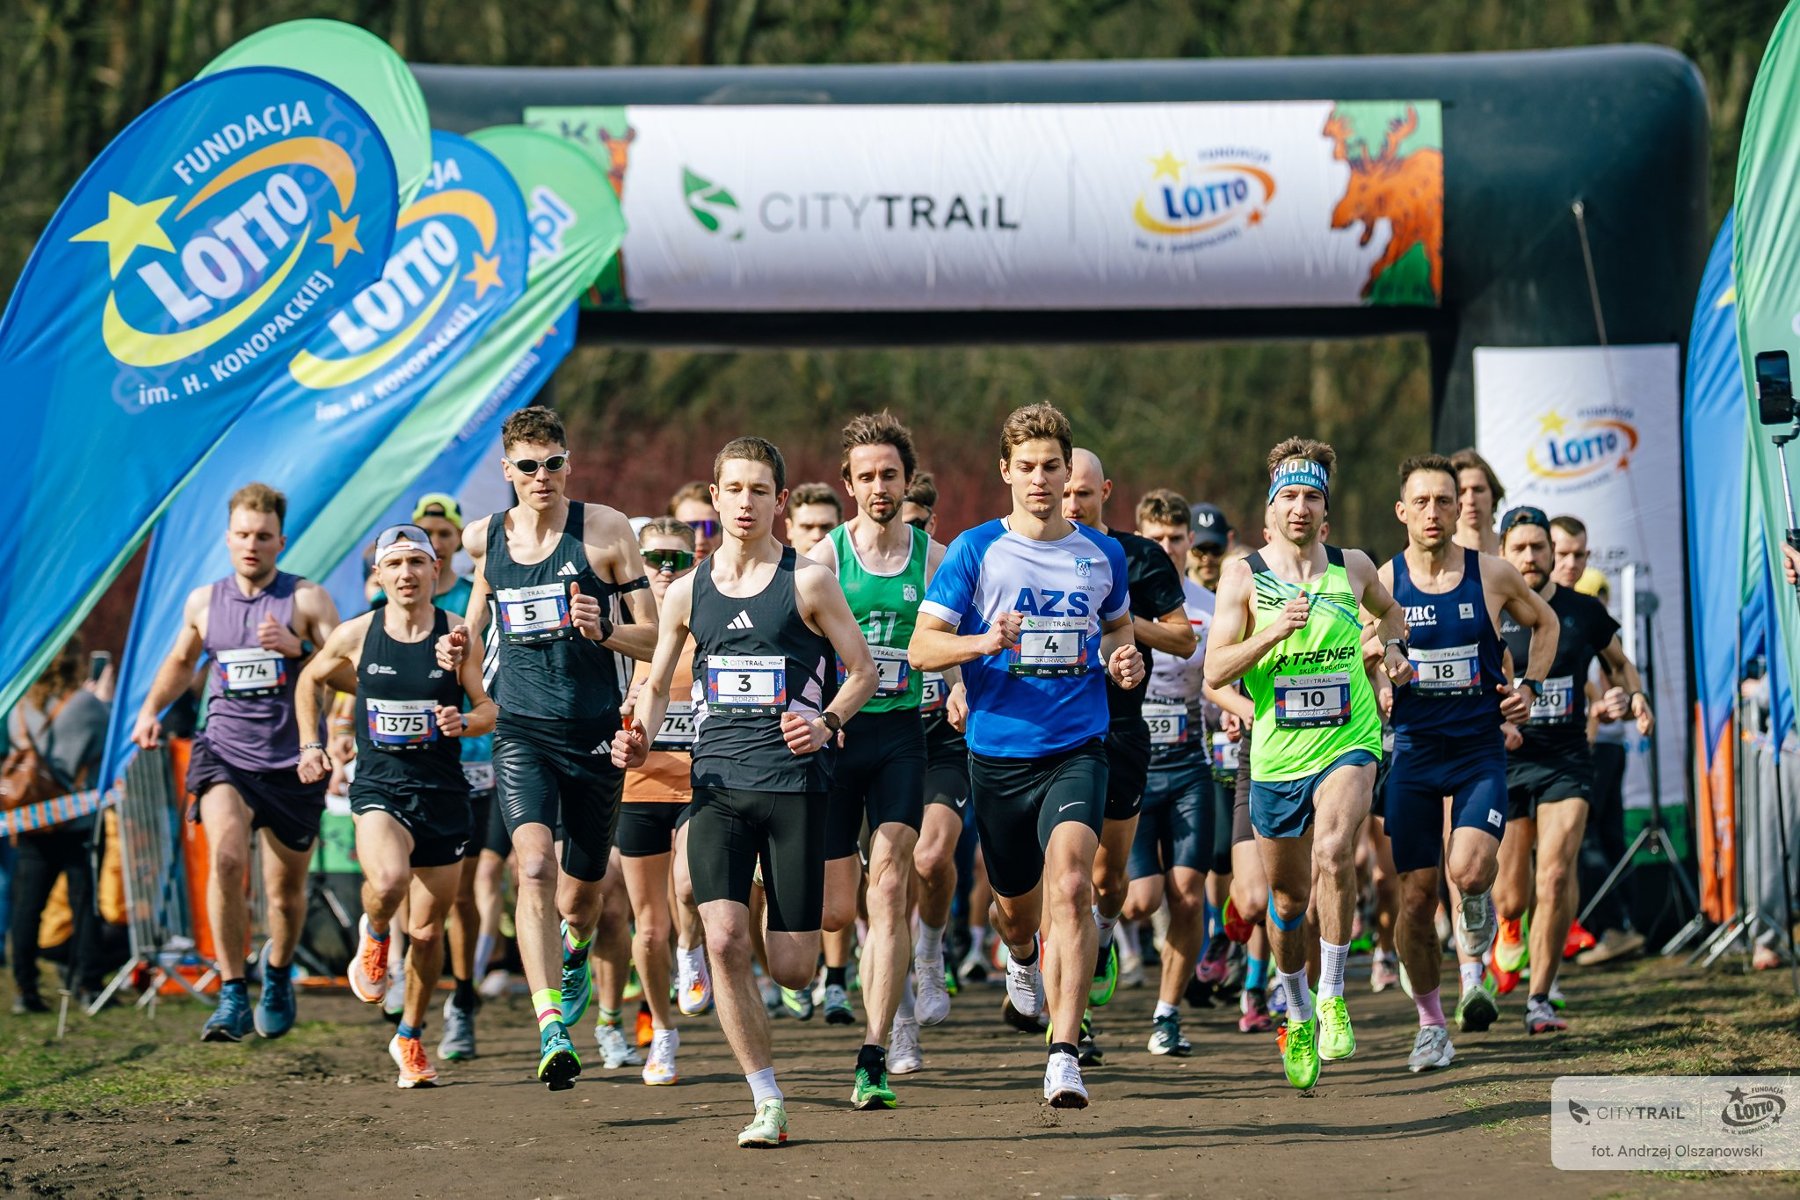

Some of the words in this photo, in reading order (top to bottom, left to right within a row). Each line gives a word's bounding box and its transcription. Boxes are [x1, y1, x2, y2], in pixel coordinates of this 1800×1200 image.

[173, 100, 313, 185] FUNDACJA
[1162, 178, 1249, 220] LOTTO
[137, 173, 308, 325] LOTTO
[328, 221, 459, 352] LOTTO
[138, 384, 178, 405] im.
[182, 371, 208, 395] H.
[210, 270, 335, 382] KONOPACKIEJ
[1549, 431, 1618, 467] LOTTO
[523, 604, 537, 621] 5
[1013, 588, 1090, 617] AZS
[867, 611, 897, 646] 57
[1044, 635, 1059, 653] 4
[1292, 646, 1355, 666] TRENER
[235, 663, 268, 679] 774
[738, 674, 752, 692] 3
[1432, 664, 1454, 680] 18
[1301, 690, 1325, 708] 10
[380, 716, 424, 732] 1375
